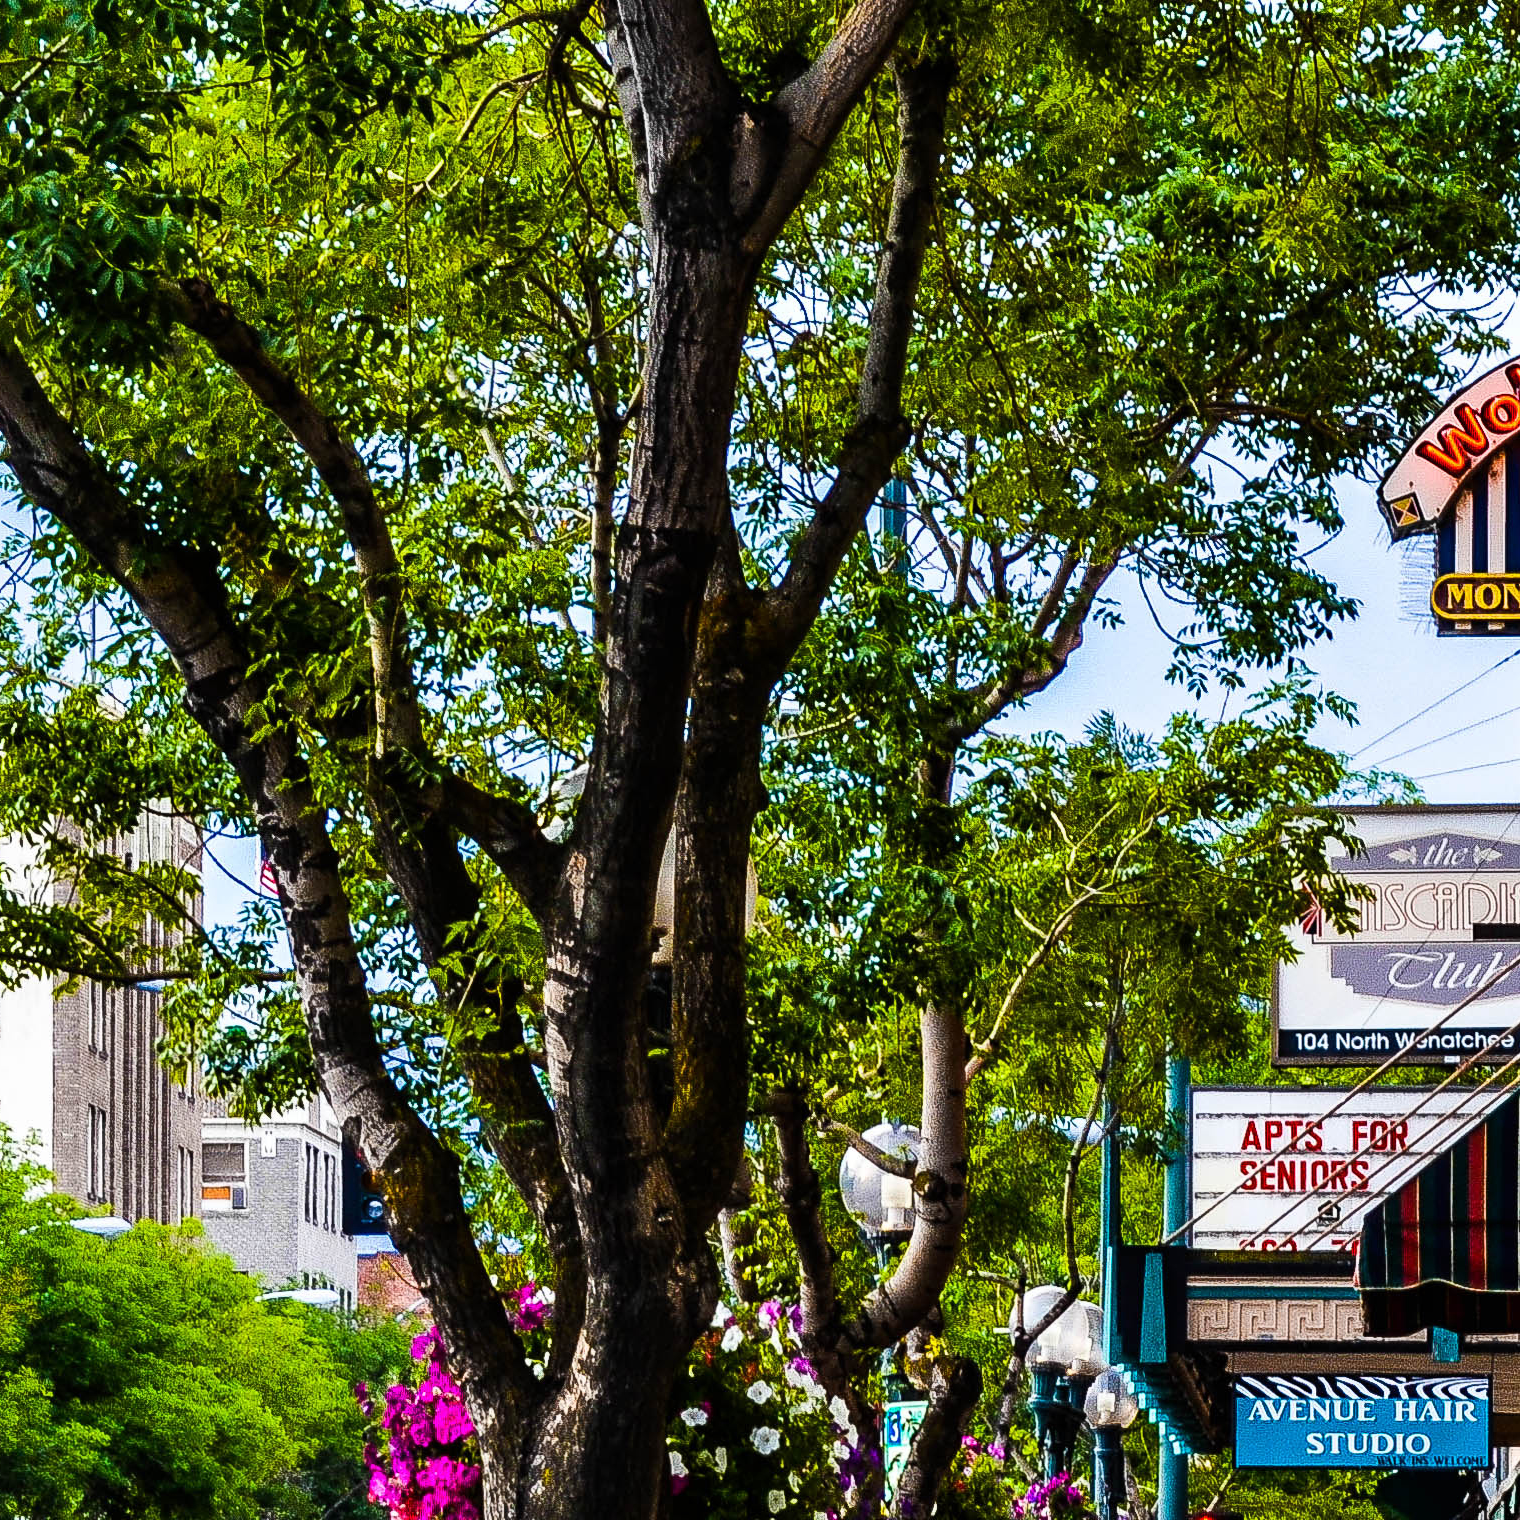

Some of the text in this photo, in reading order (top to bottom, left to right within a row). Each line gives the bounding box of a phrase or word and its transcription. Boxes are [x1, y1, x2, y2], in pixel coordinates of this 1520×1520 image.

[1423, 837, 1468, 866] the
[1379, 951, 1511, 989] Club
[1295, 1032, 1328, 1050] 104
[1335, 1032, 1389, 1050] North
[1395, 1032, 1514, 1050] Wenatchee
[1241, 1120, 1409, 1151] APTS FOR
[1240, 1160, 1369, 1191] SENIORS
[1248, 1399, 1478, 1422] AVENUE HAIR
[1306, 1433, 1431, 1455] STUDIO
[1377, 1456, 1407, 1465] WALK
[1412, 1456, 1429, 1465] INS
